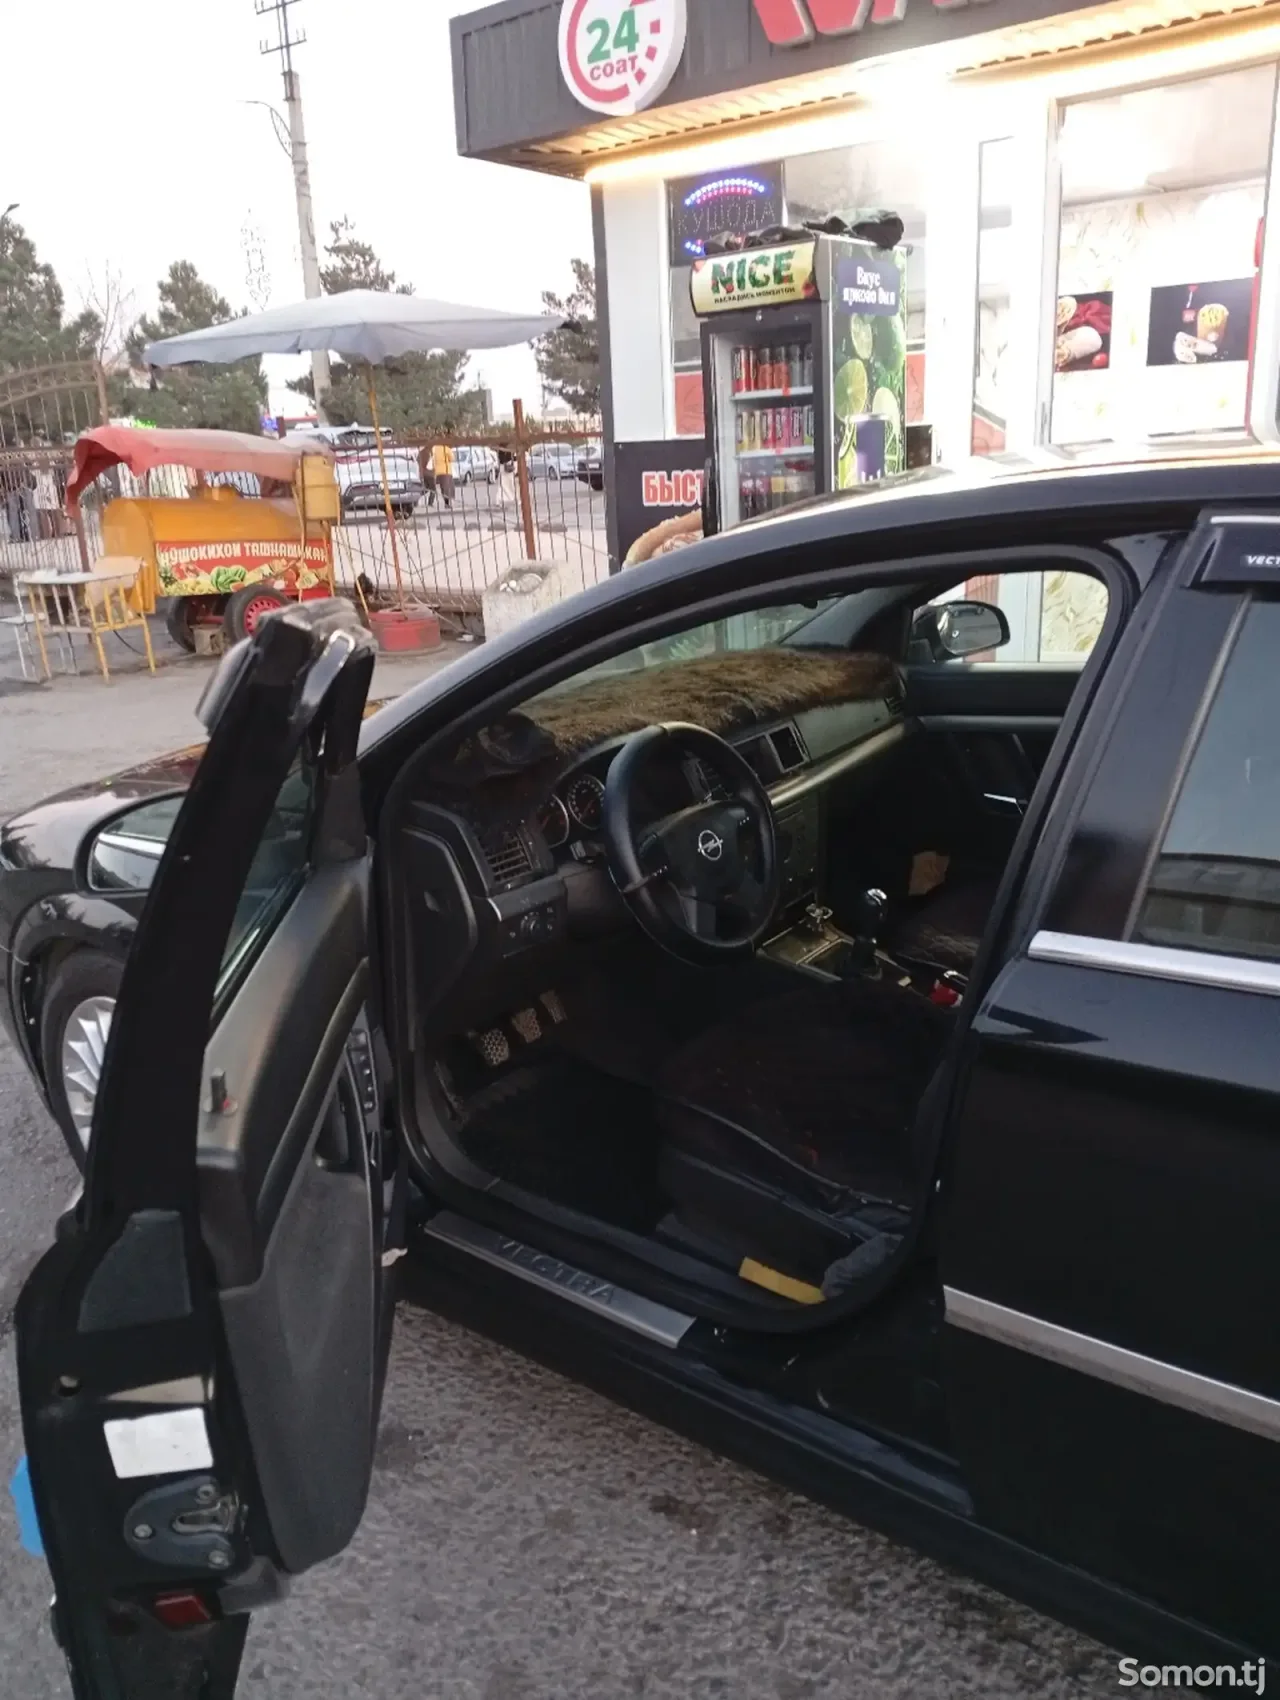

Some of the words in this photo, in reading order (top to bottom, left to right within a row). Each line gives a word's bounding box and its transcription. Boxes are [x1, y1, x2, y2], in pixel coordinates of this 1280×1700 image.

[586, 8, 639, 64] 24
[589, 55, 638, 81] соат
[711, 250, 795, 294] NICE
[856, 266, 881, 290] Вкус
